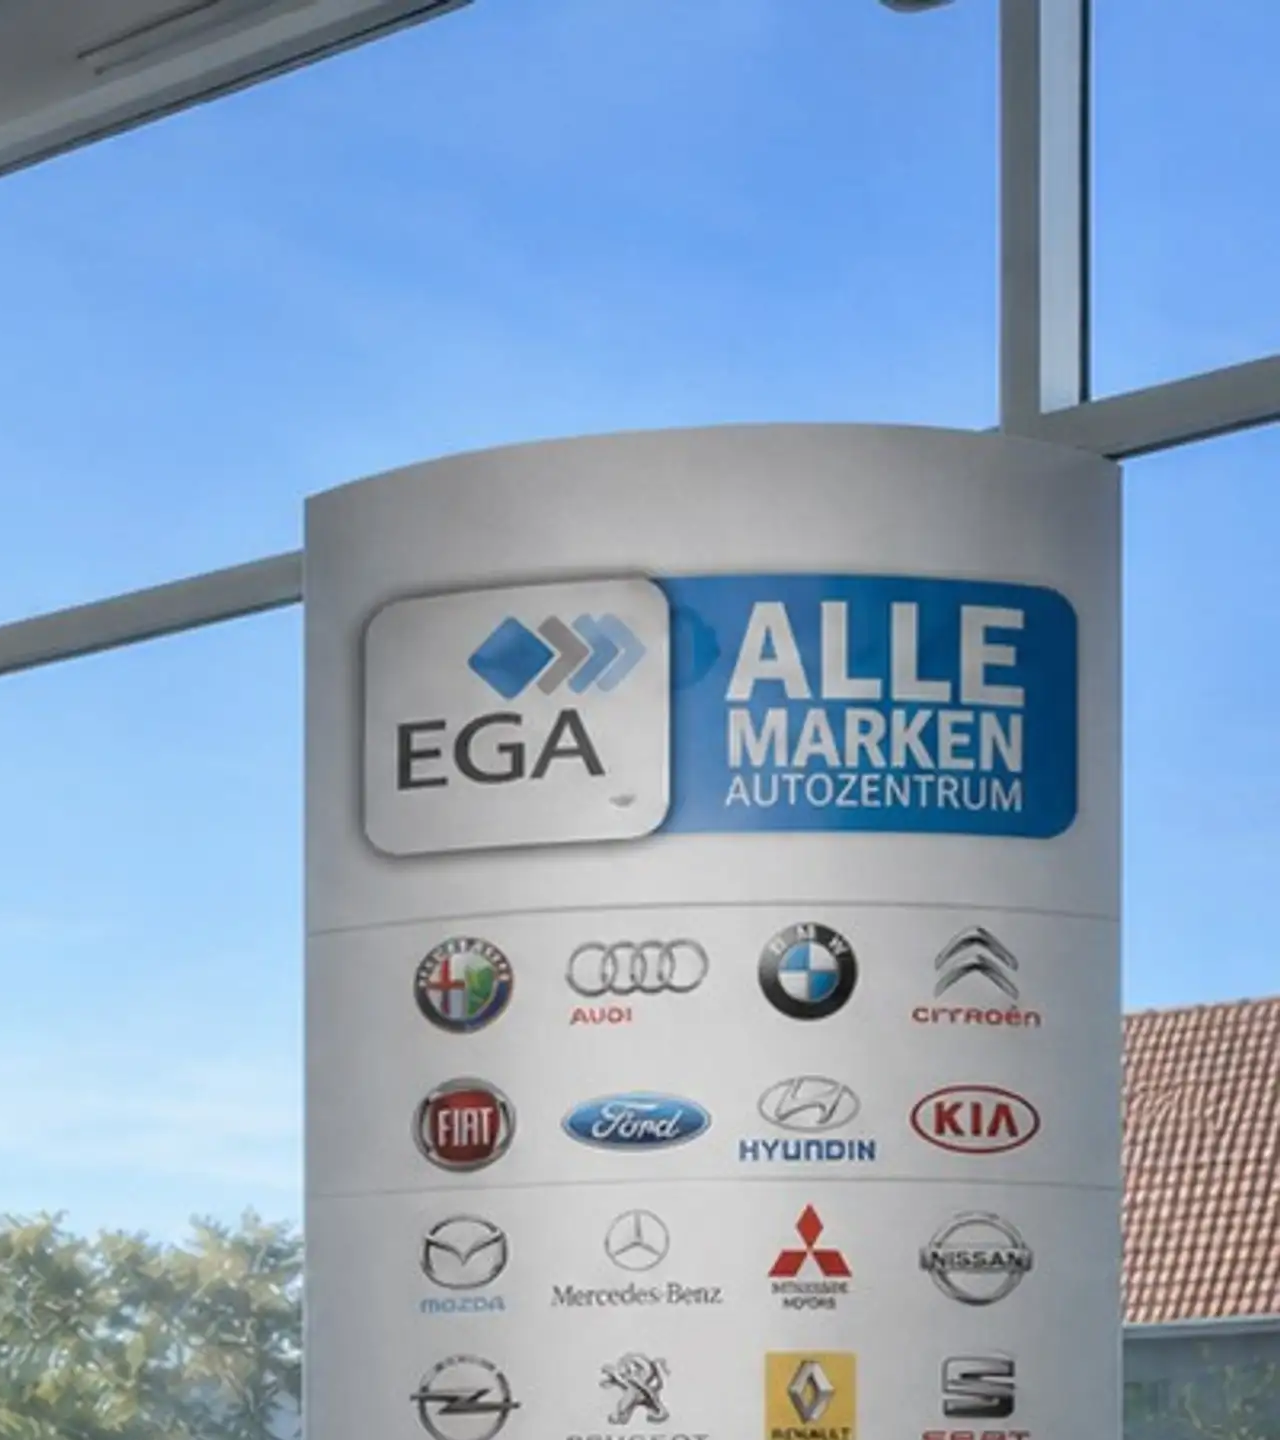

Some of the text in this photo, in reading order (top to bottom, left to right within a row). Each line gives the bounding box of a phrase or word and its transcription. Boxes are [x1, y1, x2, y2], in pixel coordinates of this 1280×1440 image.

[725, 601, 1026, 706] ALLE
[396, 709, 606, 790] EGA
[726, 707, 1023, 773] MARKEN
[725, 774, 1023, 811] AUTOZENTRUM
[437, 1107, 493, 1147] FIAT
[591, 1100, 680, 1138] Ford
[934, 1101, 1019, 1137] KIA
[930, 1250, 1024, 1272] NISSAN
